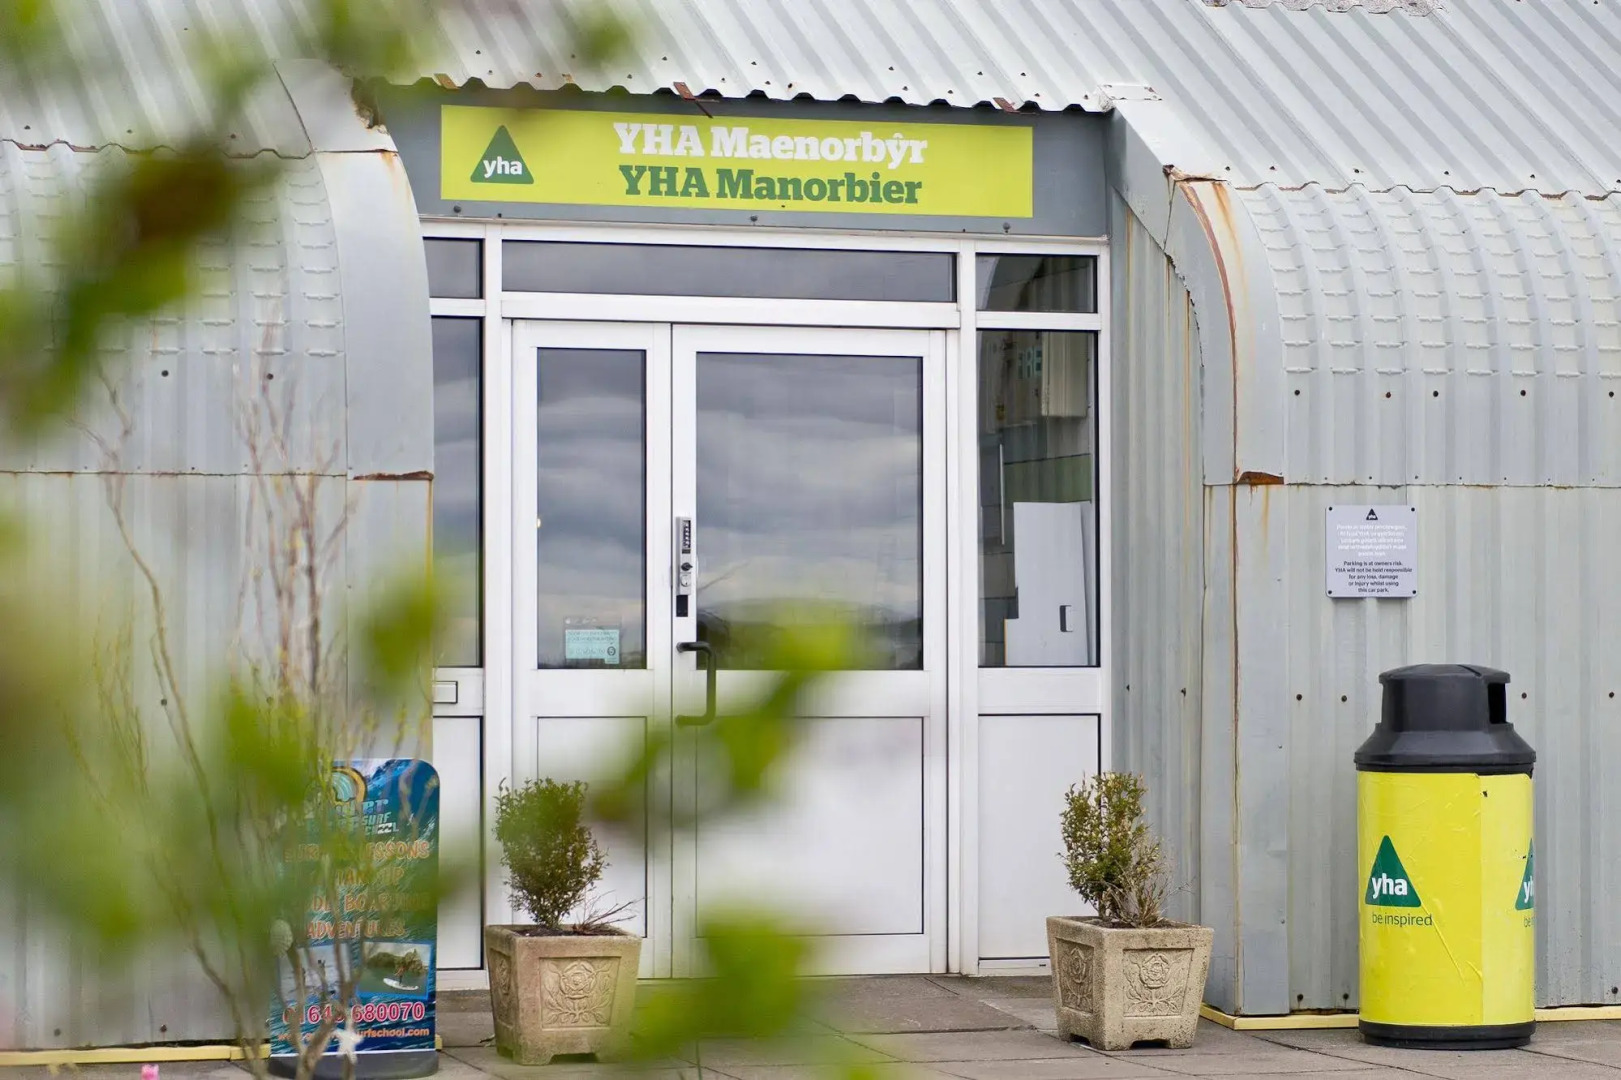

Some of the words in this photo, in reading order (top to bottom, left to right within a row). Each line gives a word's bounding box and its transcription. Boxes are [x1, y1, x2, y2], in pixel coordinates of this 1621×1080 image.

[613, 122, 705, 157] YHA
[710, 126, 928, 169] Maenorbŷr
[483, 156, 523, 178] yha
[619, 164, 710, 198] YHA
[716, 168, 922, 204] Manorbier
[362, 811, 393, 826] SURF
[360, 840, 430, 860] ESSONS
[1371, 872, 1408, 899] yha
[1372, 911, 1383, 924] be
[1384, 912, 1432, 928] inspired
[350, 1002, 425, 1023] 680070
